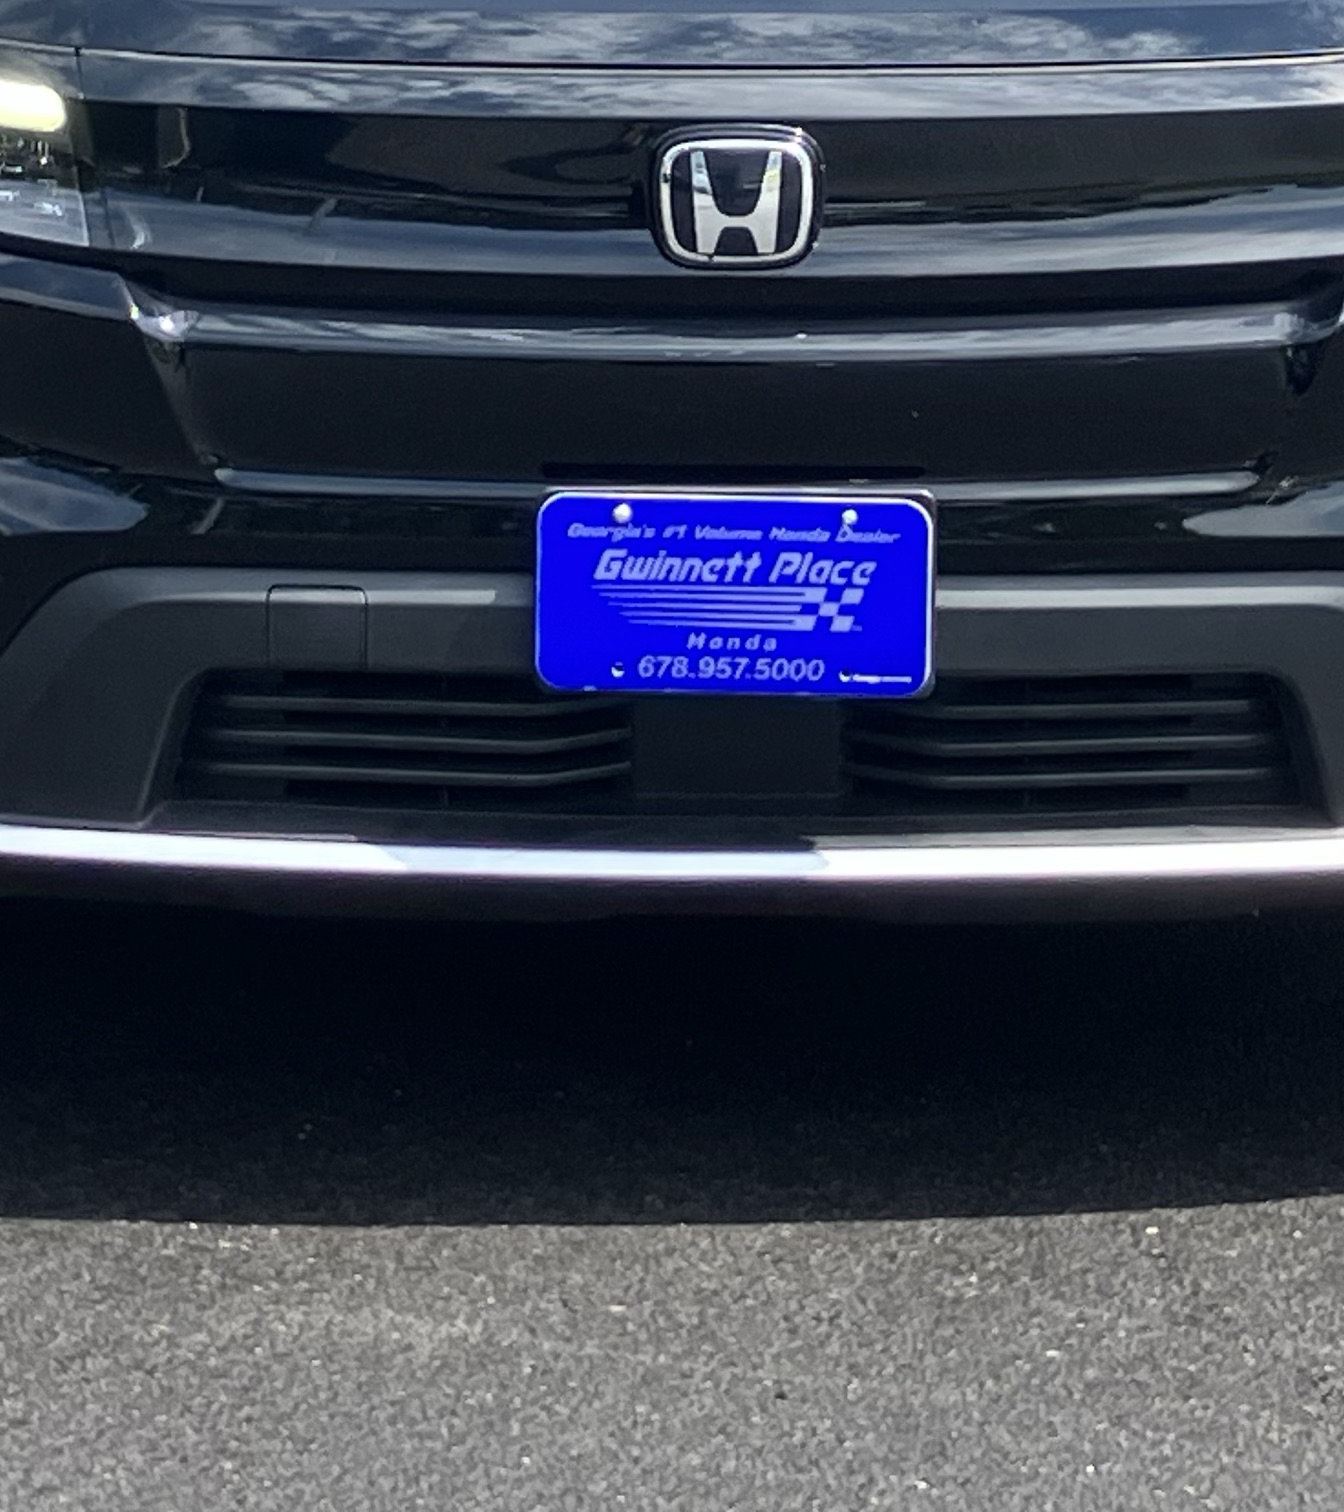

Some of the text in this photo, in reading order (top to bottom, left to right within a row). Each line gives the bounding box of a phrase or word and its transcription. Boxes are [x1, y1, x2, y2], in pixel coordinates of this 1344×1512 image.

[768, 526, 831, 543] Honda
[592, 548, 878, 586] Gwinnett Place
[686, 632, 777, 652] Honda
[637, 655, 826, 682] 678.957.5000
